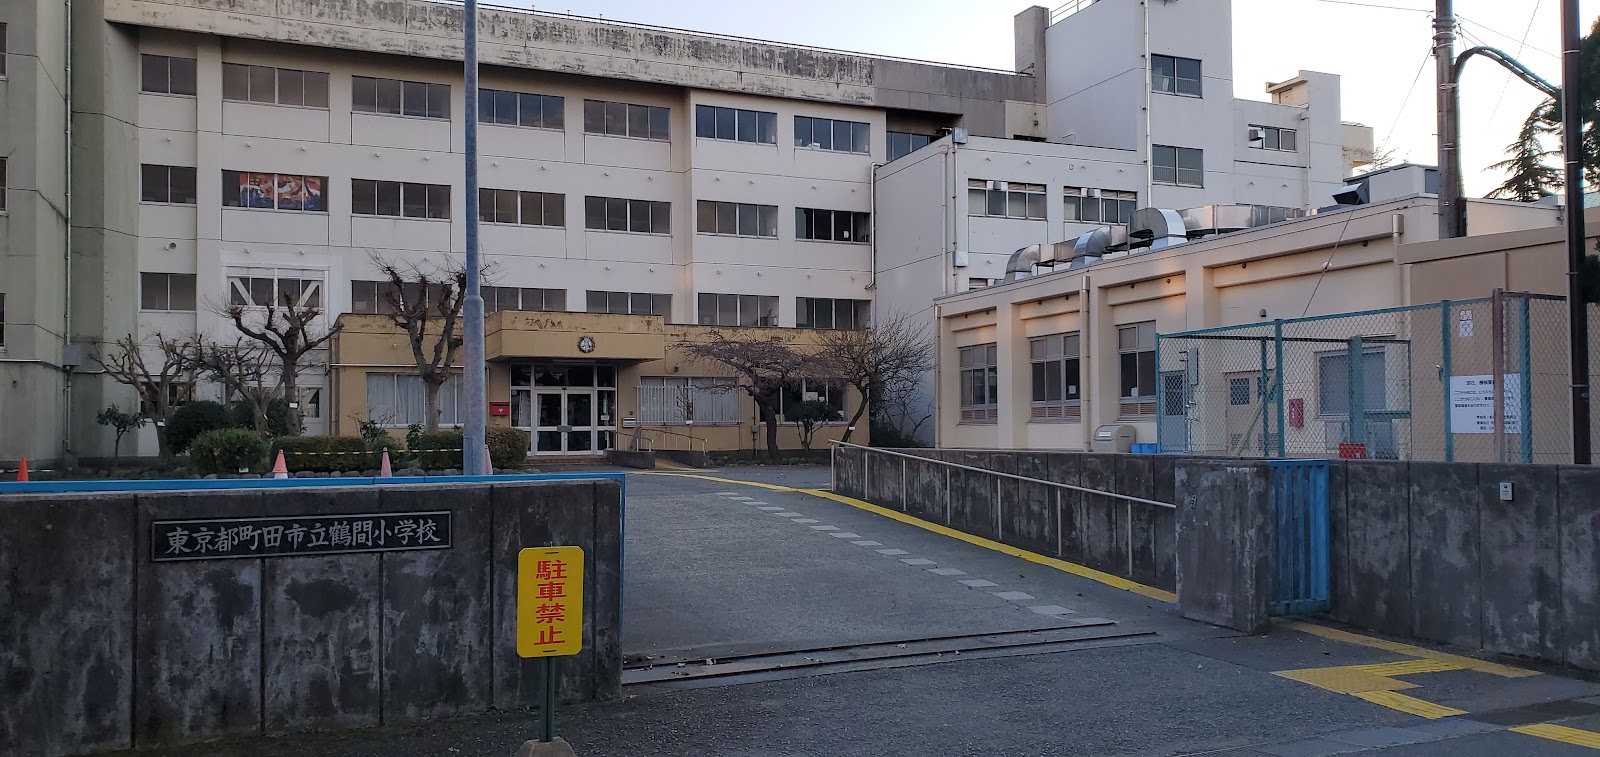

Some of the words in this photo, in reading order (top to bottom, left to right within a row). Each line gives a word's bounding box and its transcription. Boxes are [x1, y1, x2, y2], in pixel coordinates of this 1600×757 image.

[165, 519, 441, 555] 東京都町田市立鶴間小学校
[534, 559, 567, 645] 駐車禁止
